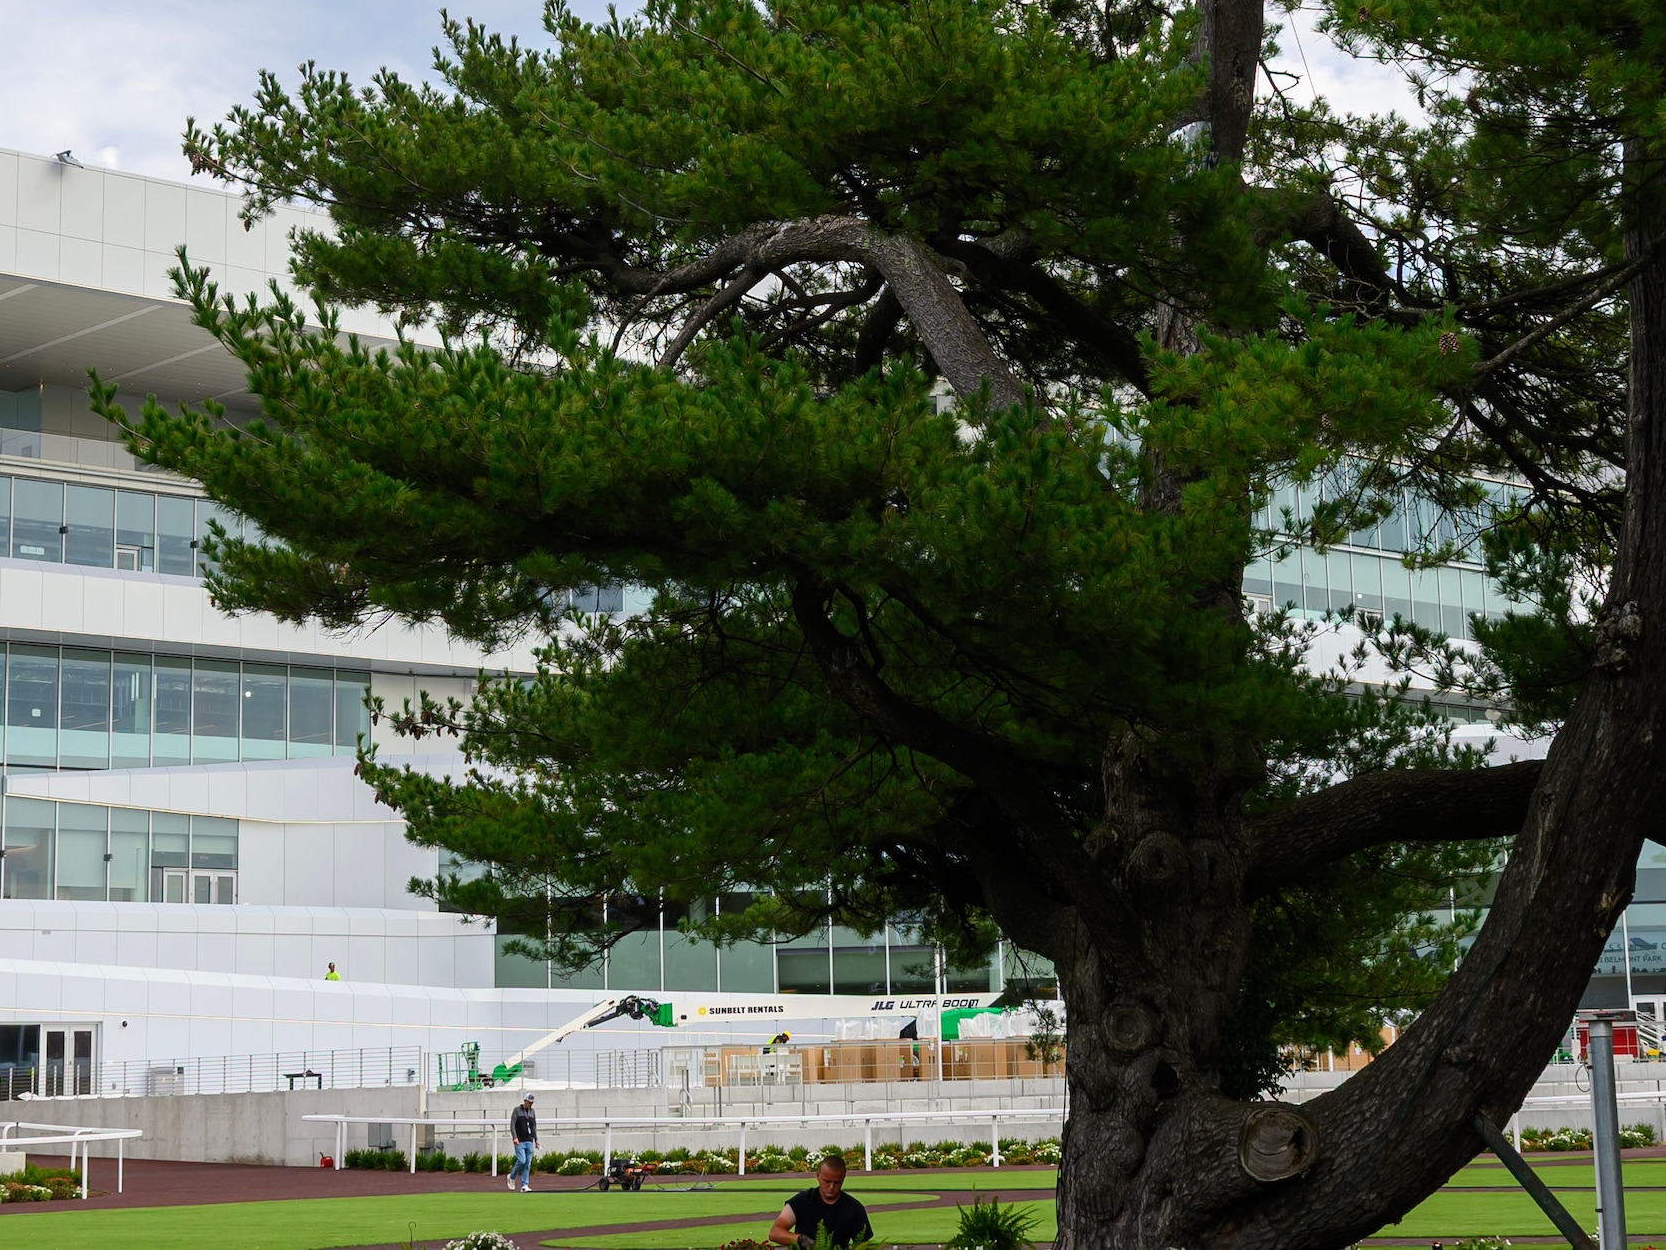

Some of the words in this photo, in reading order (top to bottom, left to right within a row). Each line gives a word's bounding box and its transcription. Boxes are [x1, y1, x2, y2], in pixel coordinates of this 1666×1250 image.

[1604, 955, 1641, 963] BELMNT
[709, 1006, 746, 1015] SUNBELT
[747, 1005, 784, 1014] RENTALS
[871, 1001, 895, 1011] JLG
[942, 999, 979, 1008] BOOM
